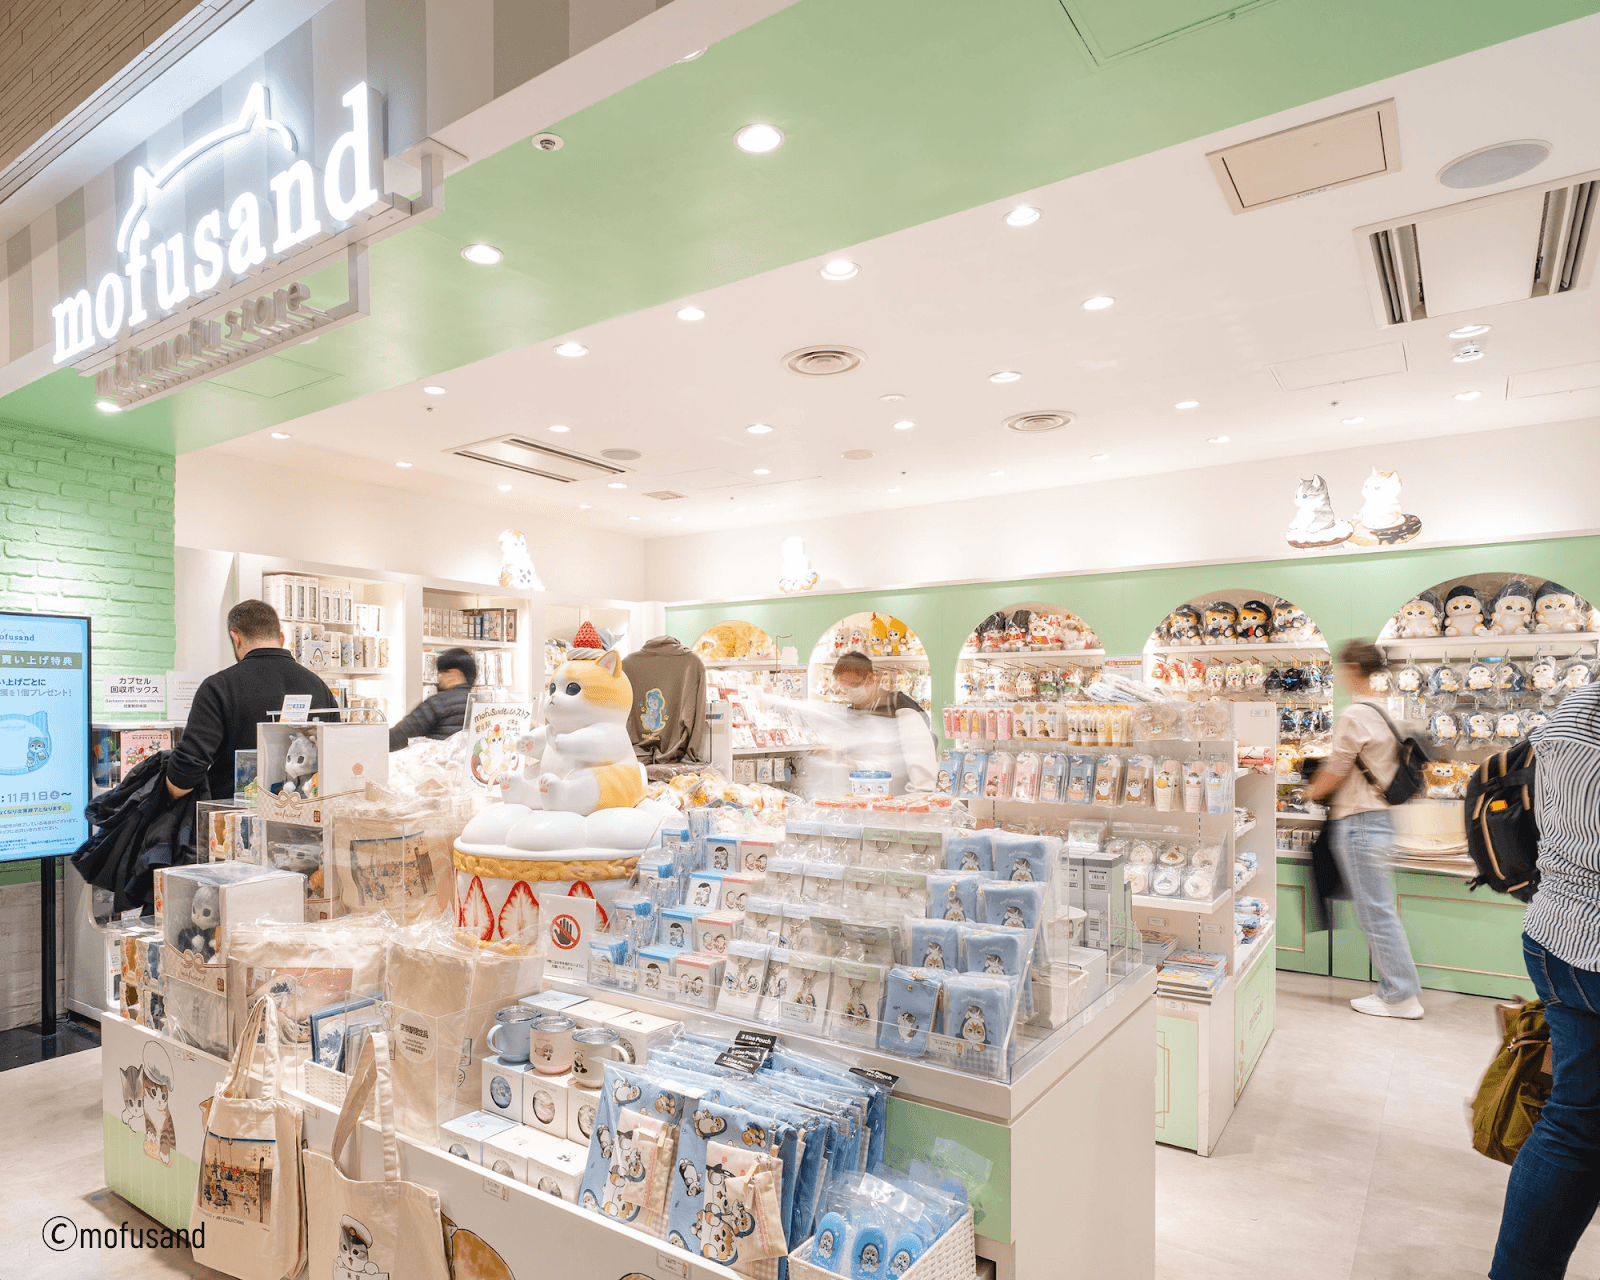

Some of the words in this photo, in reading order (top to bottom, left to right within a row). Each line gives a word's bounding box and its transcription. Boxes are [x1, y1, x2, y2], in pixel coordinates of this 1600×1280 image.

[52, 81, 379, 364] mofusand
[95, 316, 221, 396] mofumofu
[224, 281, 311, 341] store
[119, 677, 152, 685] カプセル
[756, 1036, 771, 1045] Pouch
